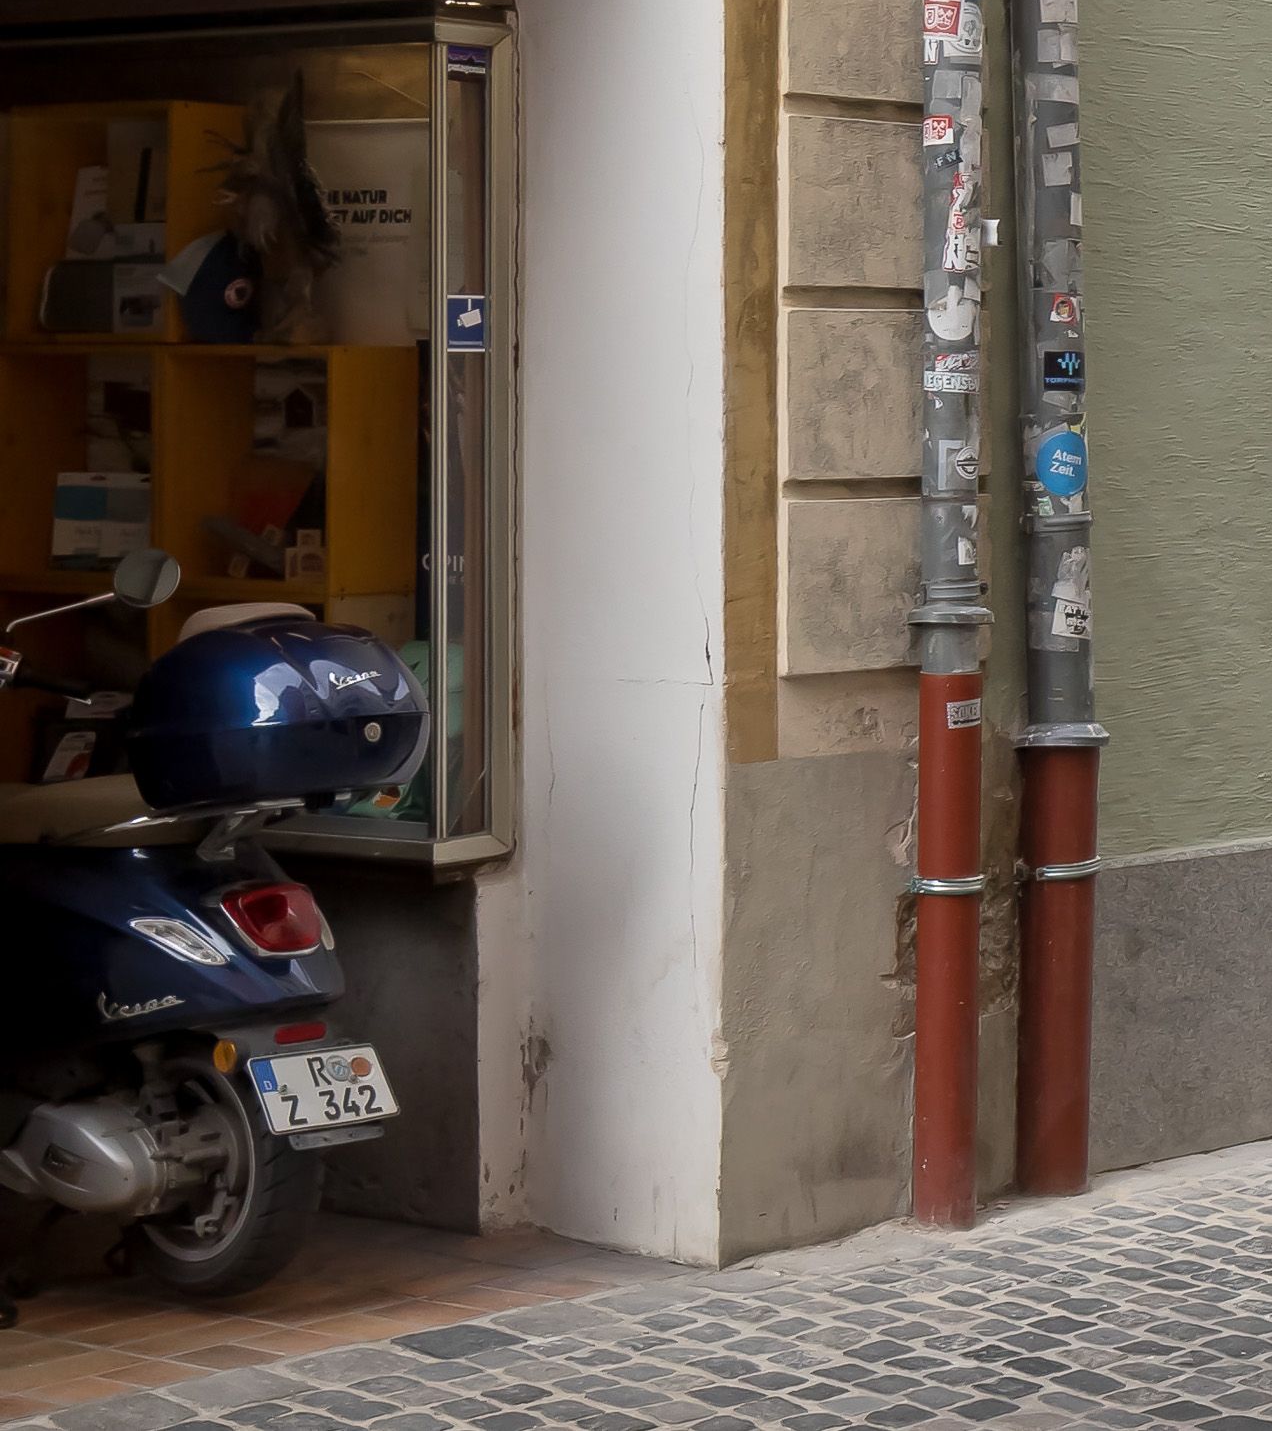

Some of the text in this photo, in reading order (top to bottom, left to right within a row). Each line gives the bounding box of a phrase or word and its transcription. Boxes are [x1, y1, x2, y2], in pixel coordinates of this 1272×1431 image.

[351, 209, 376, 224] AUF
[1052, 449, 1082, 466] Atem
[329, 671, 382, 690] Vespa
[97, 991, 186, 1019] Vespa
[307, 1057, 331, 1087] R
[263, 1081, 273, 1091] D
[281, 1085, 383, 1126] Z 342
